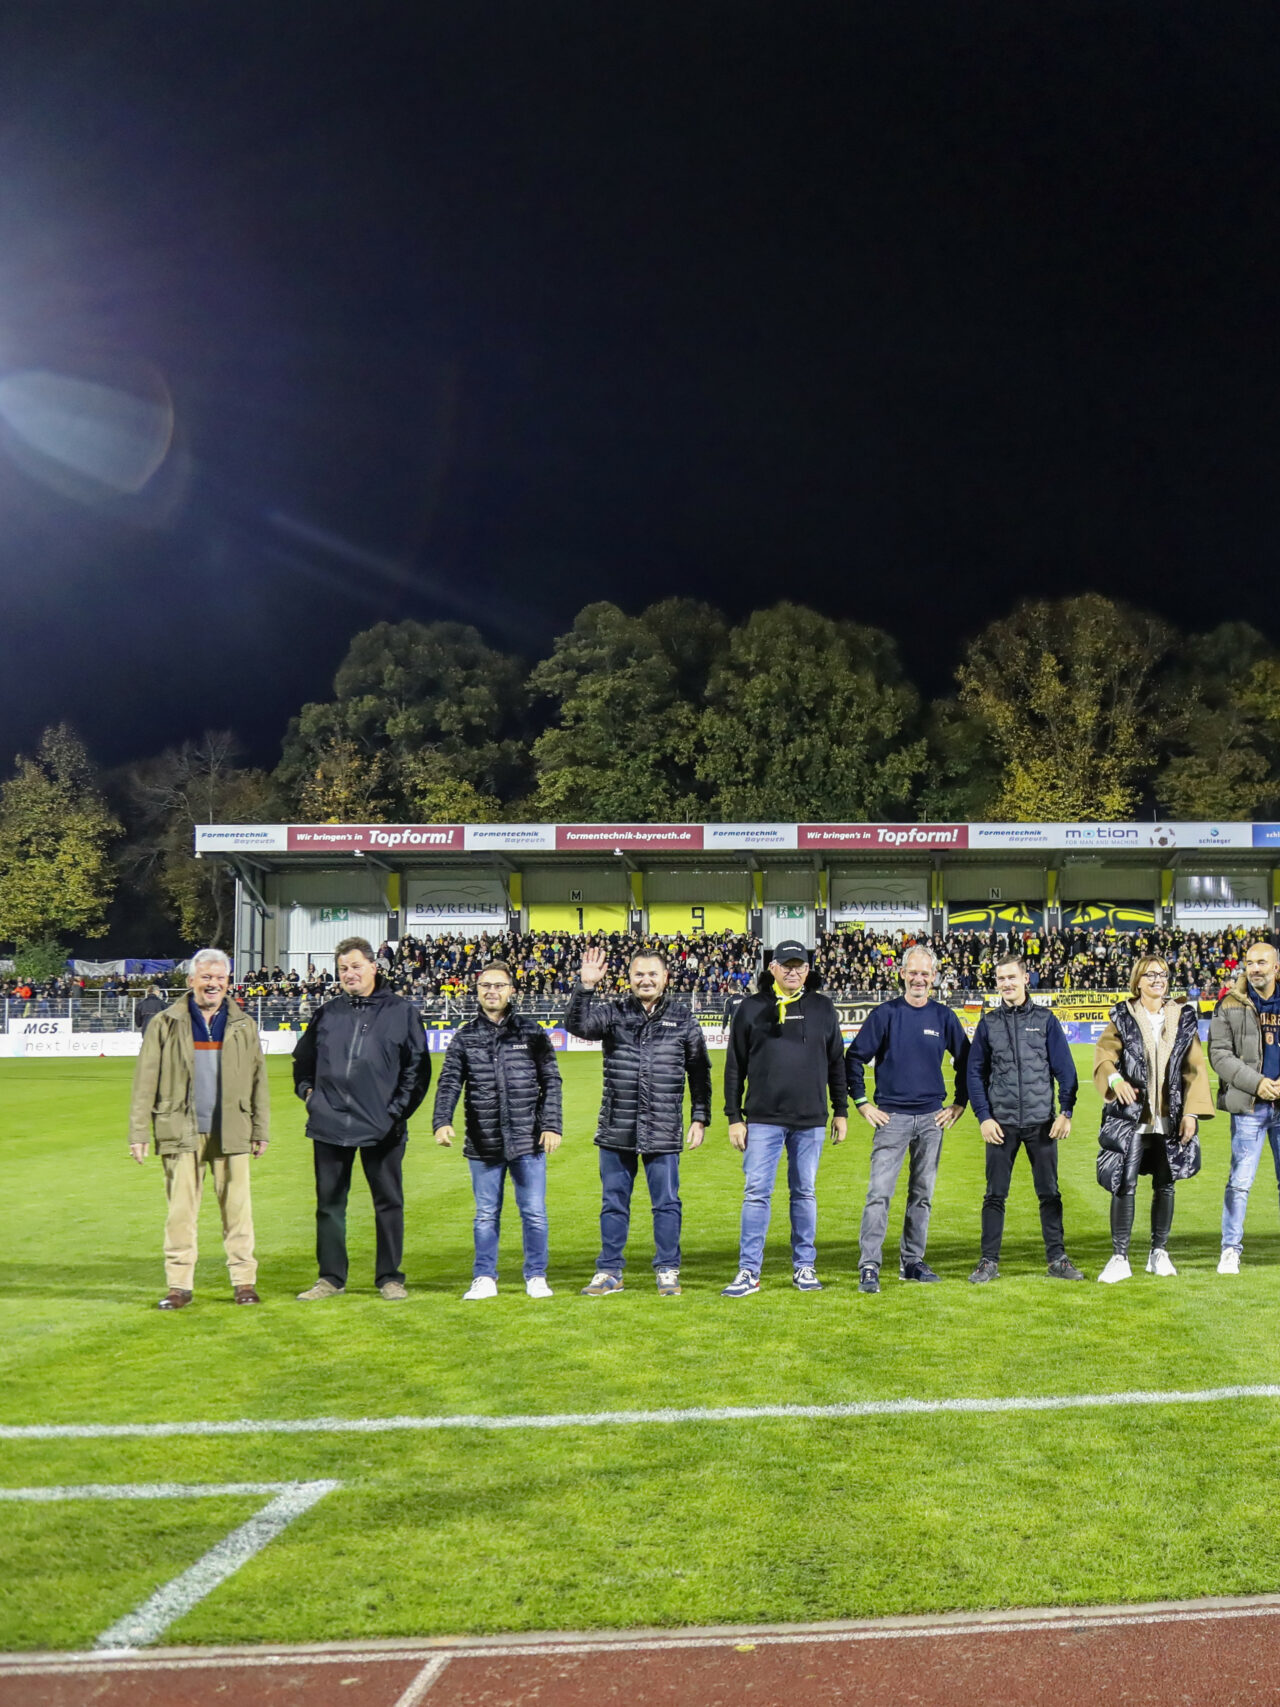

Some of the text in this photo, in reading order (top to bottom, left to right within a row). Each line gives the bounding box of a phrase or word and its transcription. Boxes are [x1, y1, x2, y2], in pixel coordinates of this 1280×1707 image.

[296, 829, 454, 847] Wir bringen's in Topform!
[566, 831, 692, 842] formentechnik-bayreuth.de
[823, 831, 861, 841] bringen's
[877, 828, 959, 846] Topform!
[1065, 827, 1138, 838] motion
[571, 890, 581, 900] M
[990, 889, 999, 898] N
[415, 903, 498, 916] BAYREUTH
[839, 900, 920, 913] BAYREUTH
[1184, 899, 1261, 912] BAYREUTH
[576, 907, 584, 930] 1
[691, 906, 705, 930] 9
[1073, 1012, 1104, 1020] SPVGG
[24, 1022, 58, 1034] MGS
